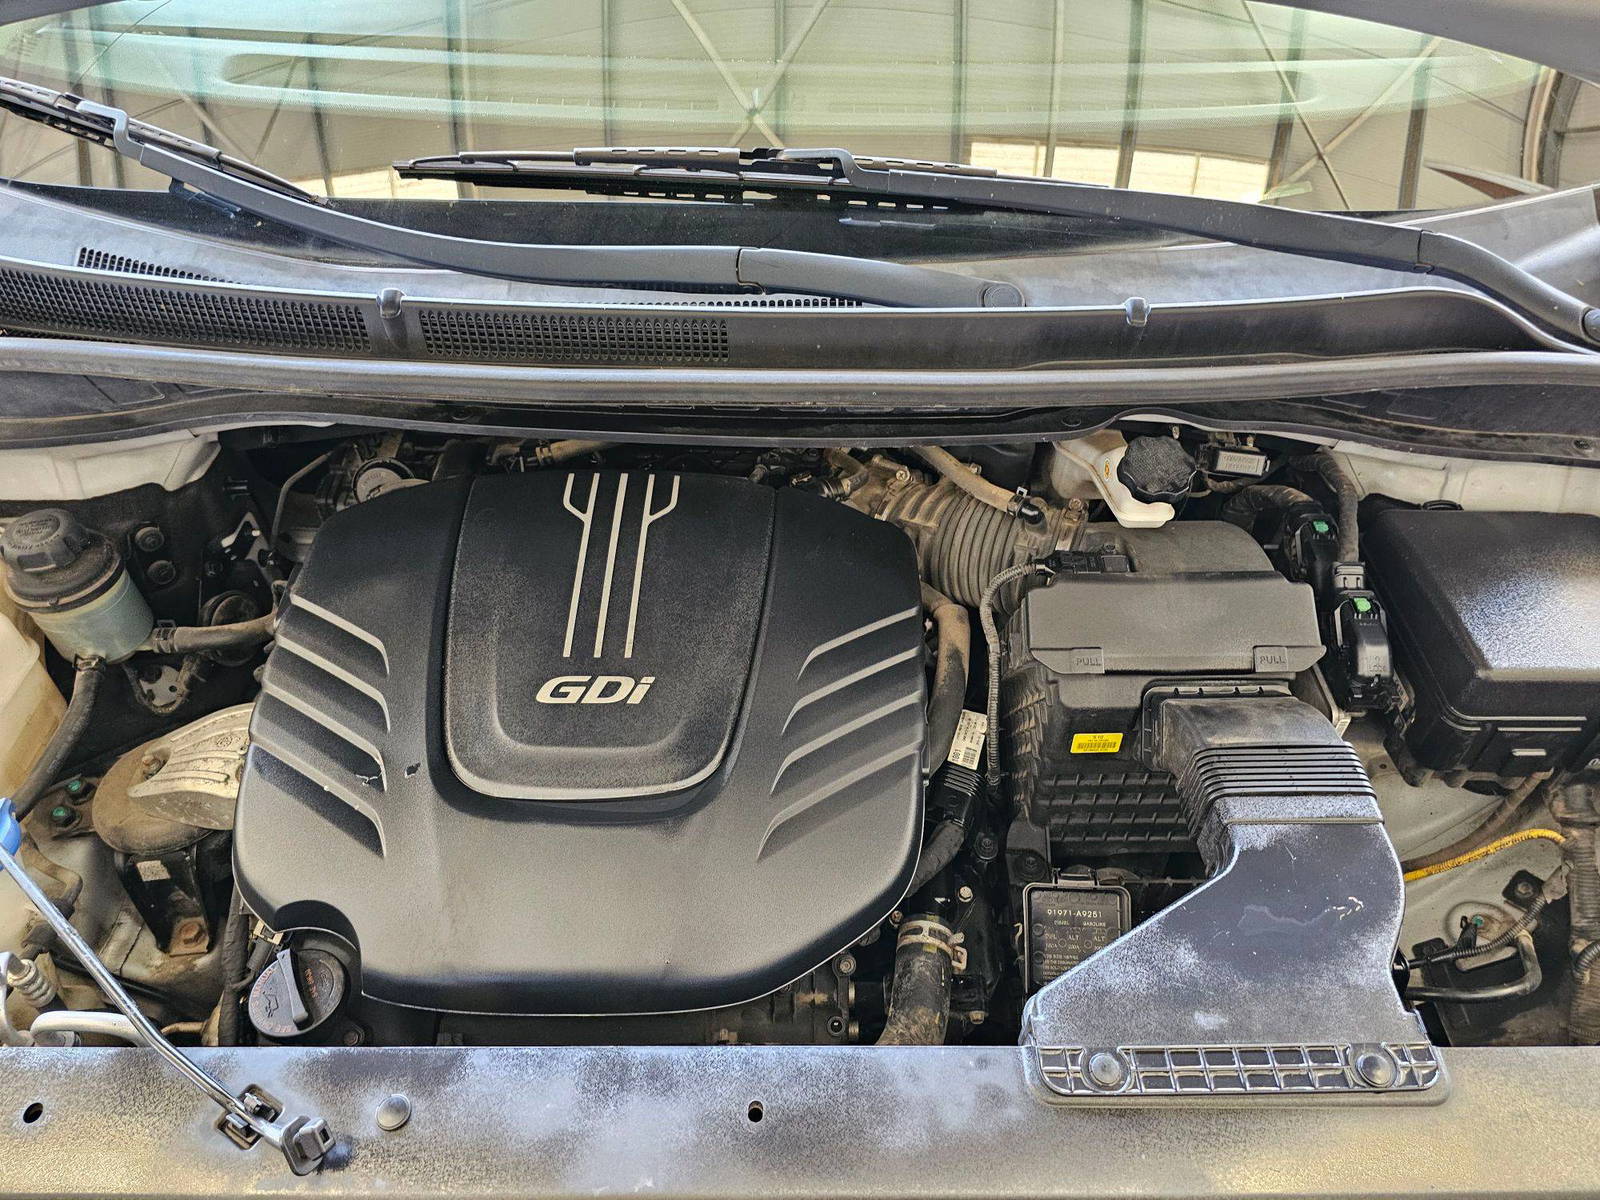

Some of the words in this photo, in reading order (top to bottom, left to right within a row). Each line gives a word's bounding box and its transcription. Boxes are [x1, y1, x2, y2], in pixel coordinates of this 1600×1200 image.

[1076, 657, 1101, 666] PULL
[1260, 655, 1286, 664] PULL
[535, 675, 656, 704] GDi
